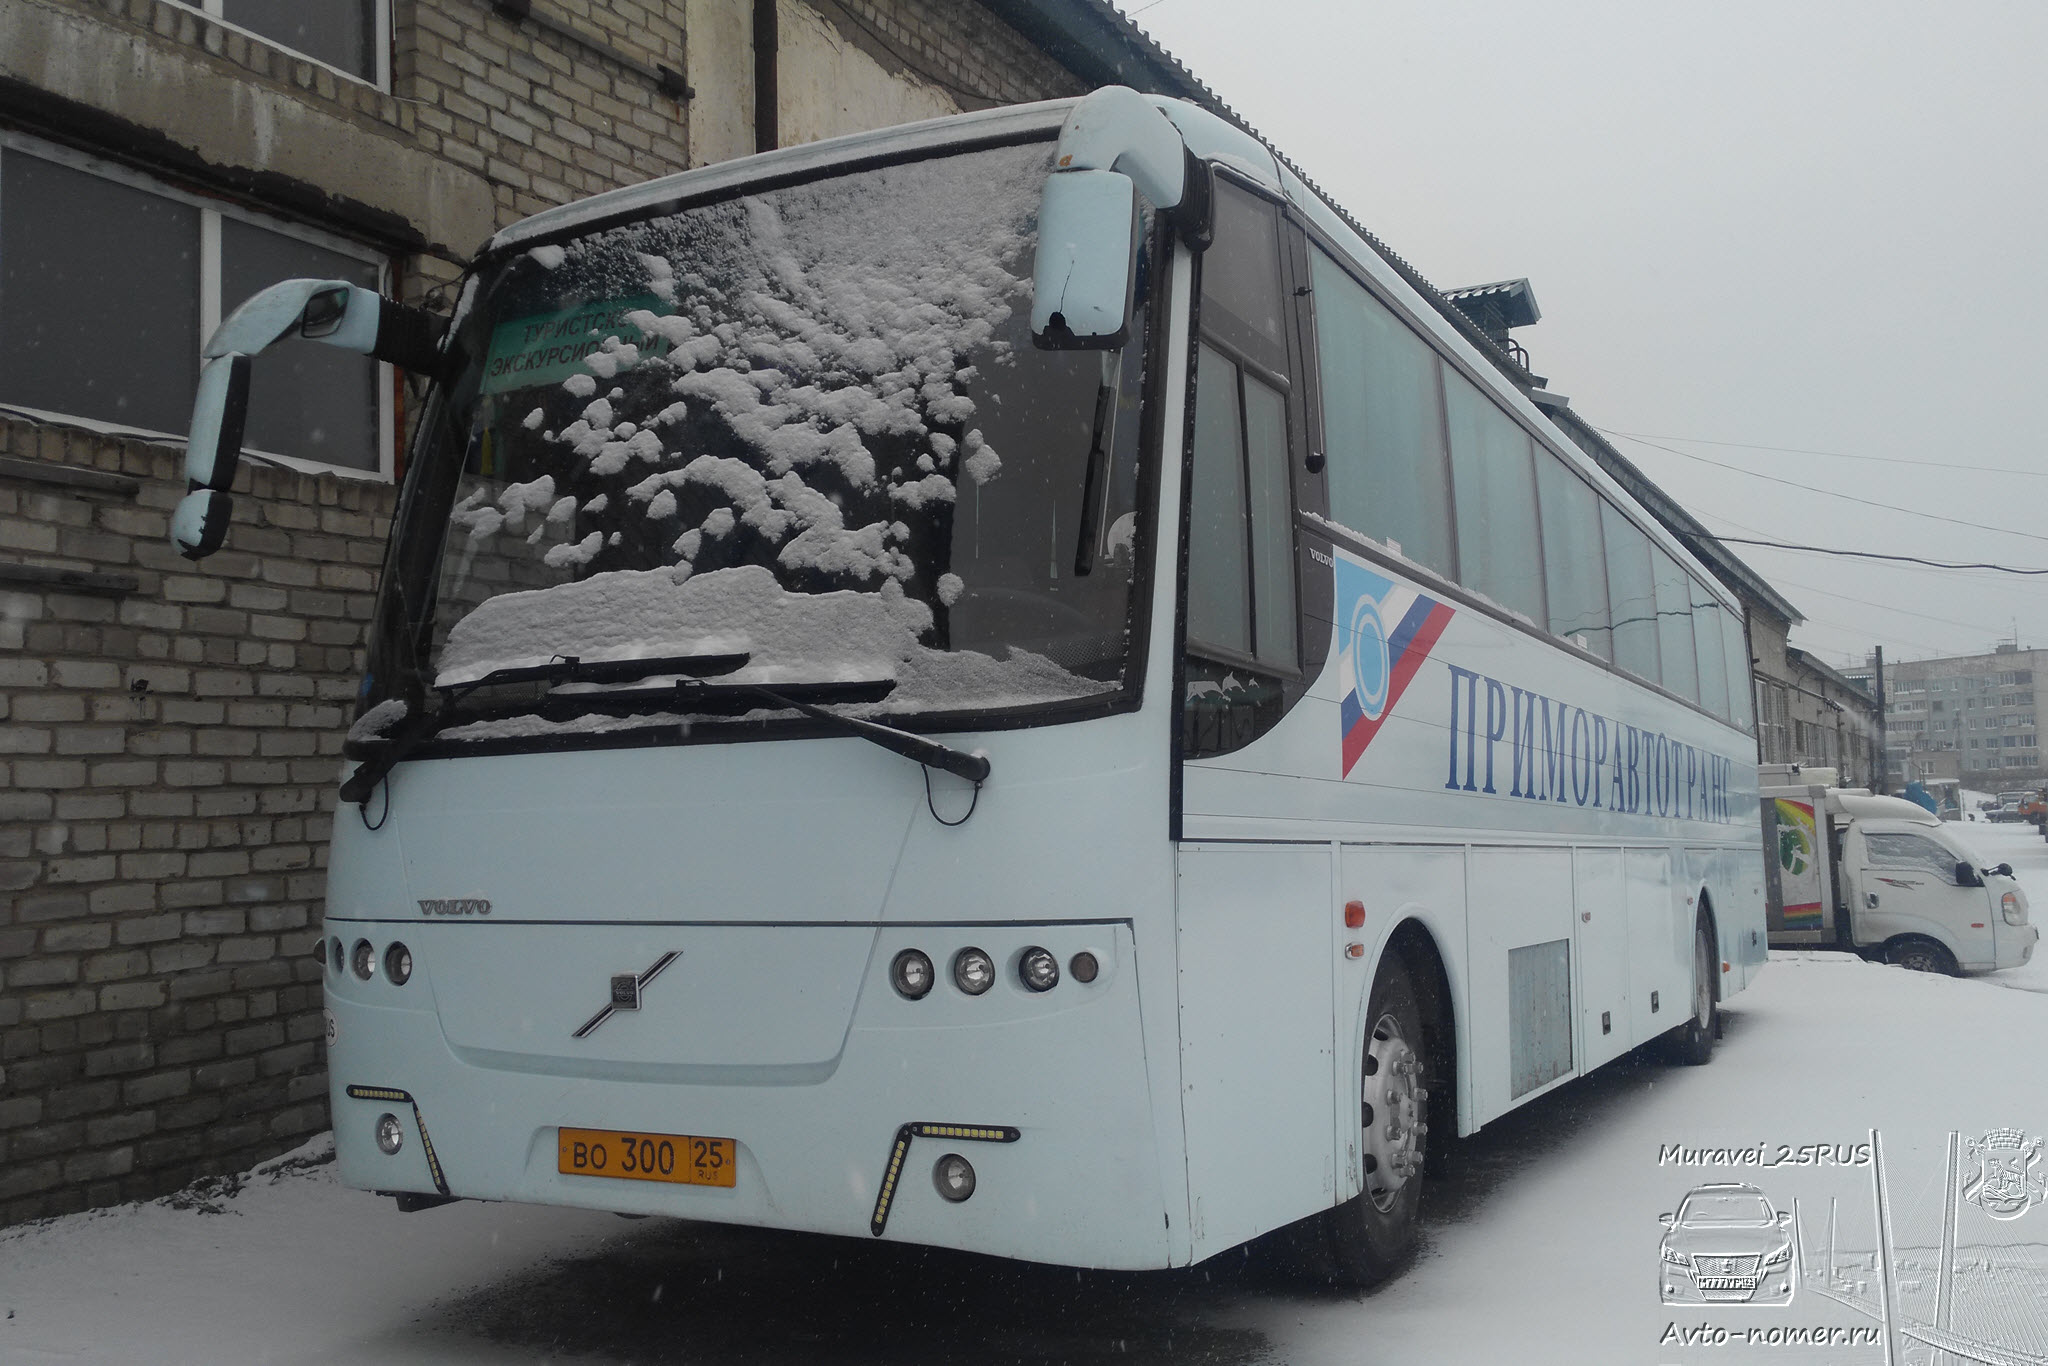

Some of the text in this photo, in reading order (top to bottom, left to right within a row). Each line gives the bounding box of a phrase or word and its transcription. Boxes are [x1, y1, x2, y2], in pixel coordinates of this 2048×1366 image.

[1309, 547, 1334, 568] VOLVO
[1444, 664, 1732, 825] ПРИМОРАВТОТРАНС
[417, 899, 492, 915] VOLVO
[621, 1138, 675, 1175] 300
[694, 1141, 723, 1168] 25
[698, 1169, 719, 1181] RUS
